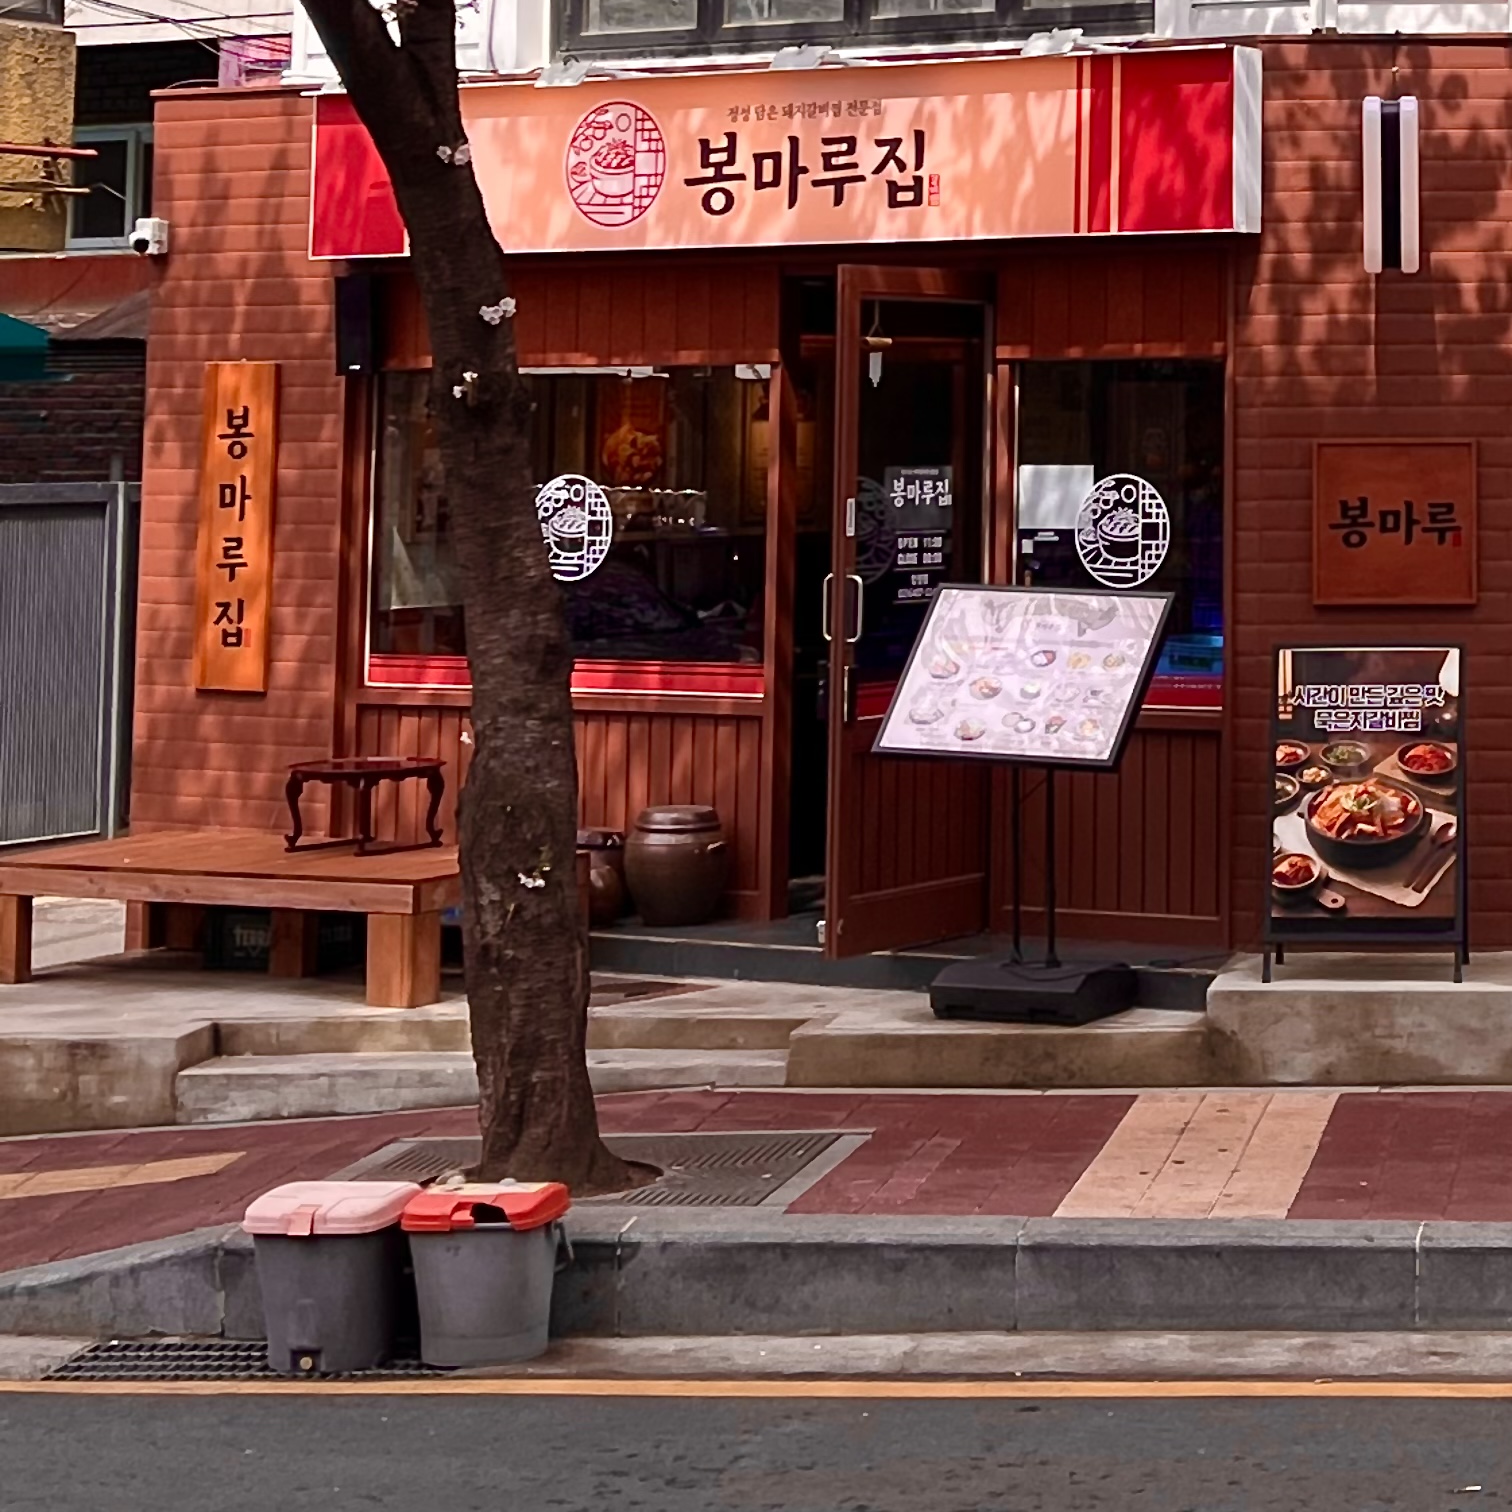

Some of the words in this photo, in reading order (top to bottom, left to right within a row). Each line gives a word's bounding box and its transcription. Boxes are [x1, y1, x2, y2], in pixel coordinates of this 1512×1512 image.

[683, 128, 926, 217] 봉마루집
[889, 476, 953, 508] 봉마루집
[212, 405, 255, 648] 봉마루집
[1328, 495, 1462, 549] 봉마루
[1292, 684, 1347, 707] 시간이
[1348, 684, 1385, 707] 만든
[1387, 684, 1423, 707] 깊은
[1424, 684, 1446, 707] 맛
[1314, 709, 1422, 732] 묵은지갈비찜
